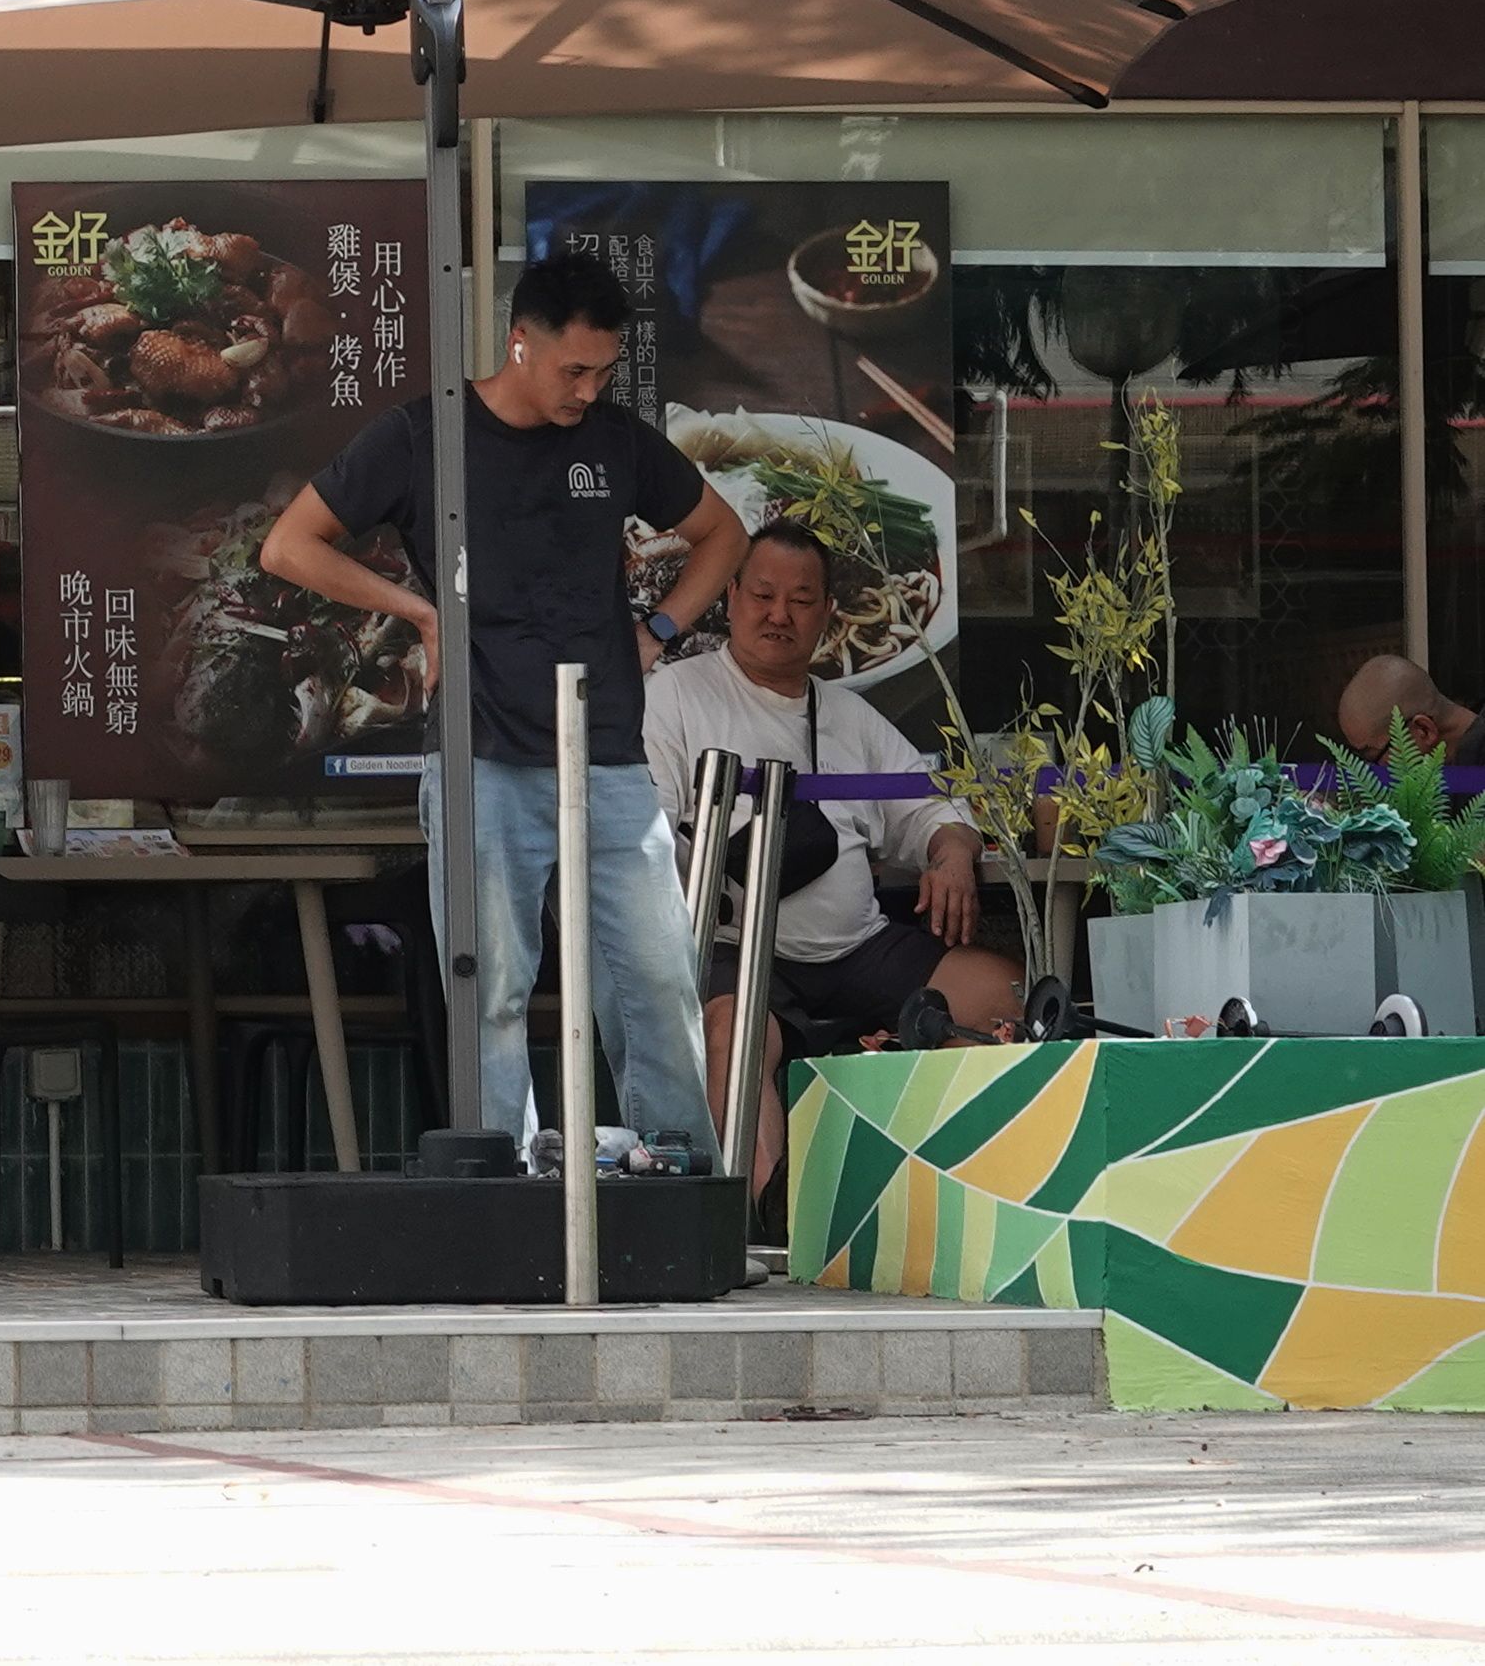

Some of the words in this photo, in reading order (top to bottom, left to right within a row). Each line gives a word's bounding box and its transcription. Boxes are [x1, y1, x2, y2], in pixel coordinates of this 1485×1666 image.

[32, 210, 109, 265] 金仔
[845, 219, 922, 272] 金仔
[47, 266, 92, 277] GOLDEN
[860, 274, 905, 285] GOLDEN
[371, 242, 406, 387] 用心制作
[60, 570, 94, 718] 晚市火鍋
[105, 588, 138, 734] 回味無窮
[350, 759, 383, 771] Golden
[386, 759, 423, 771] Noodles
